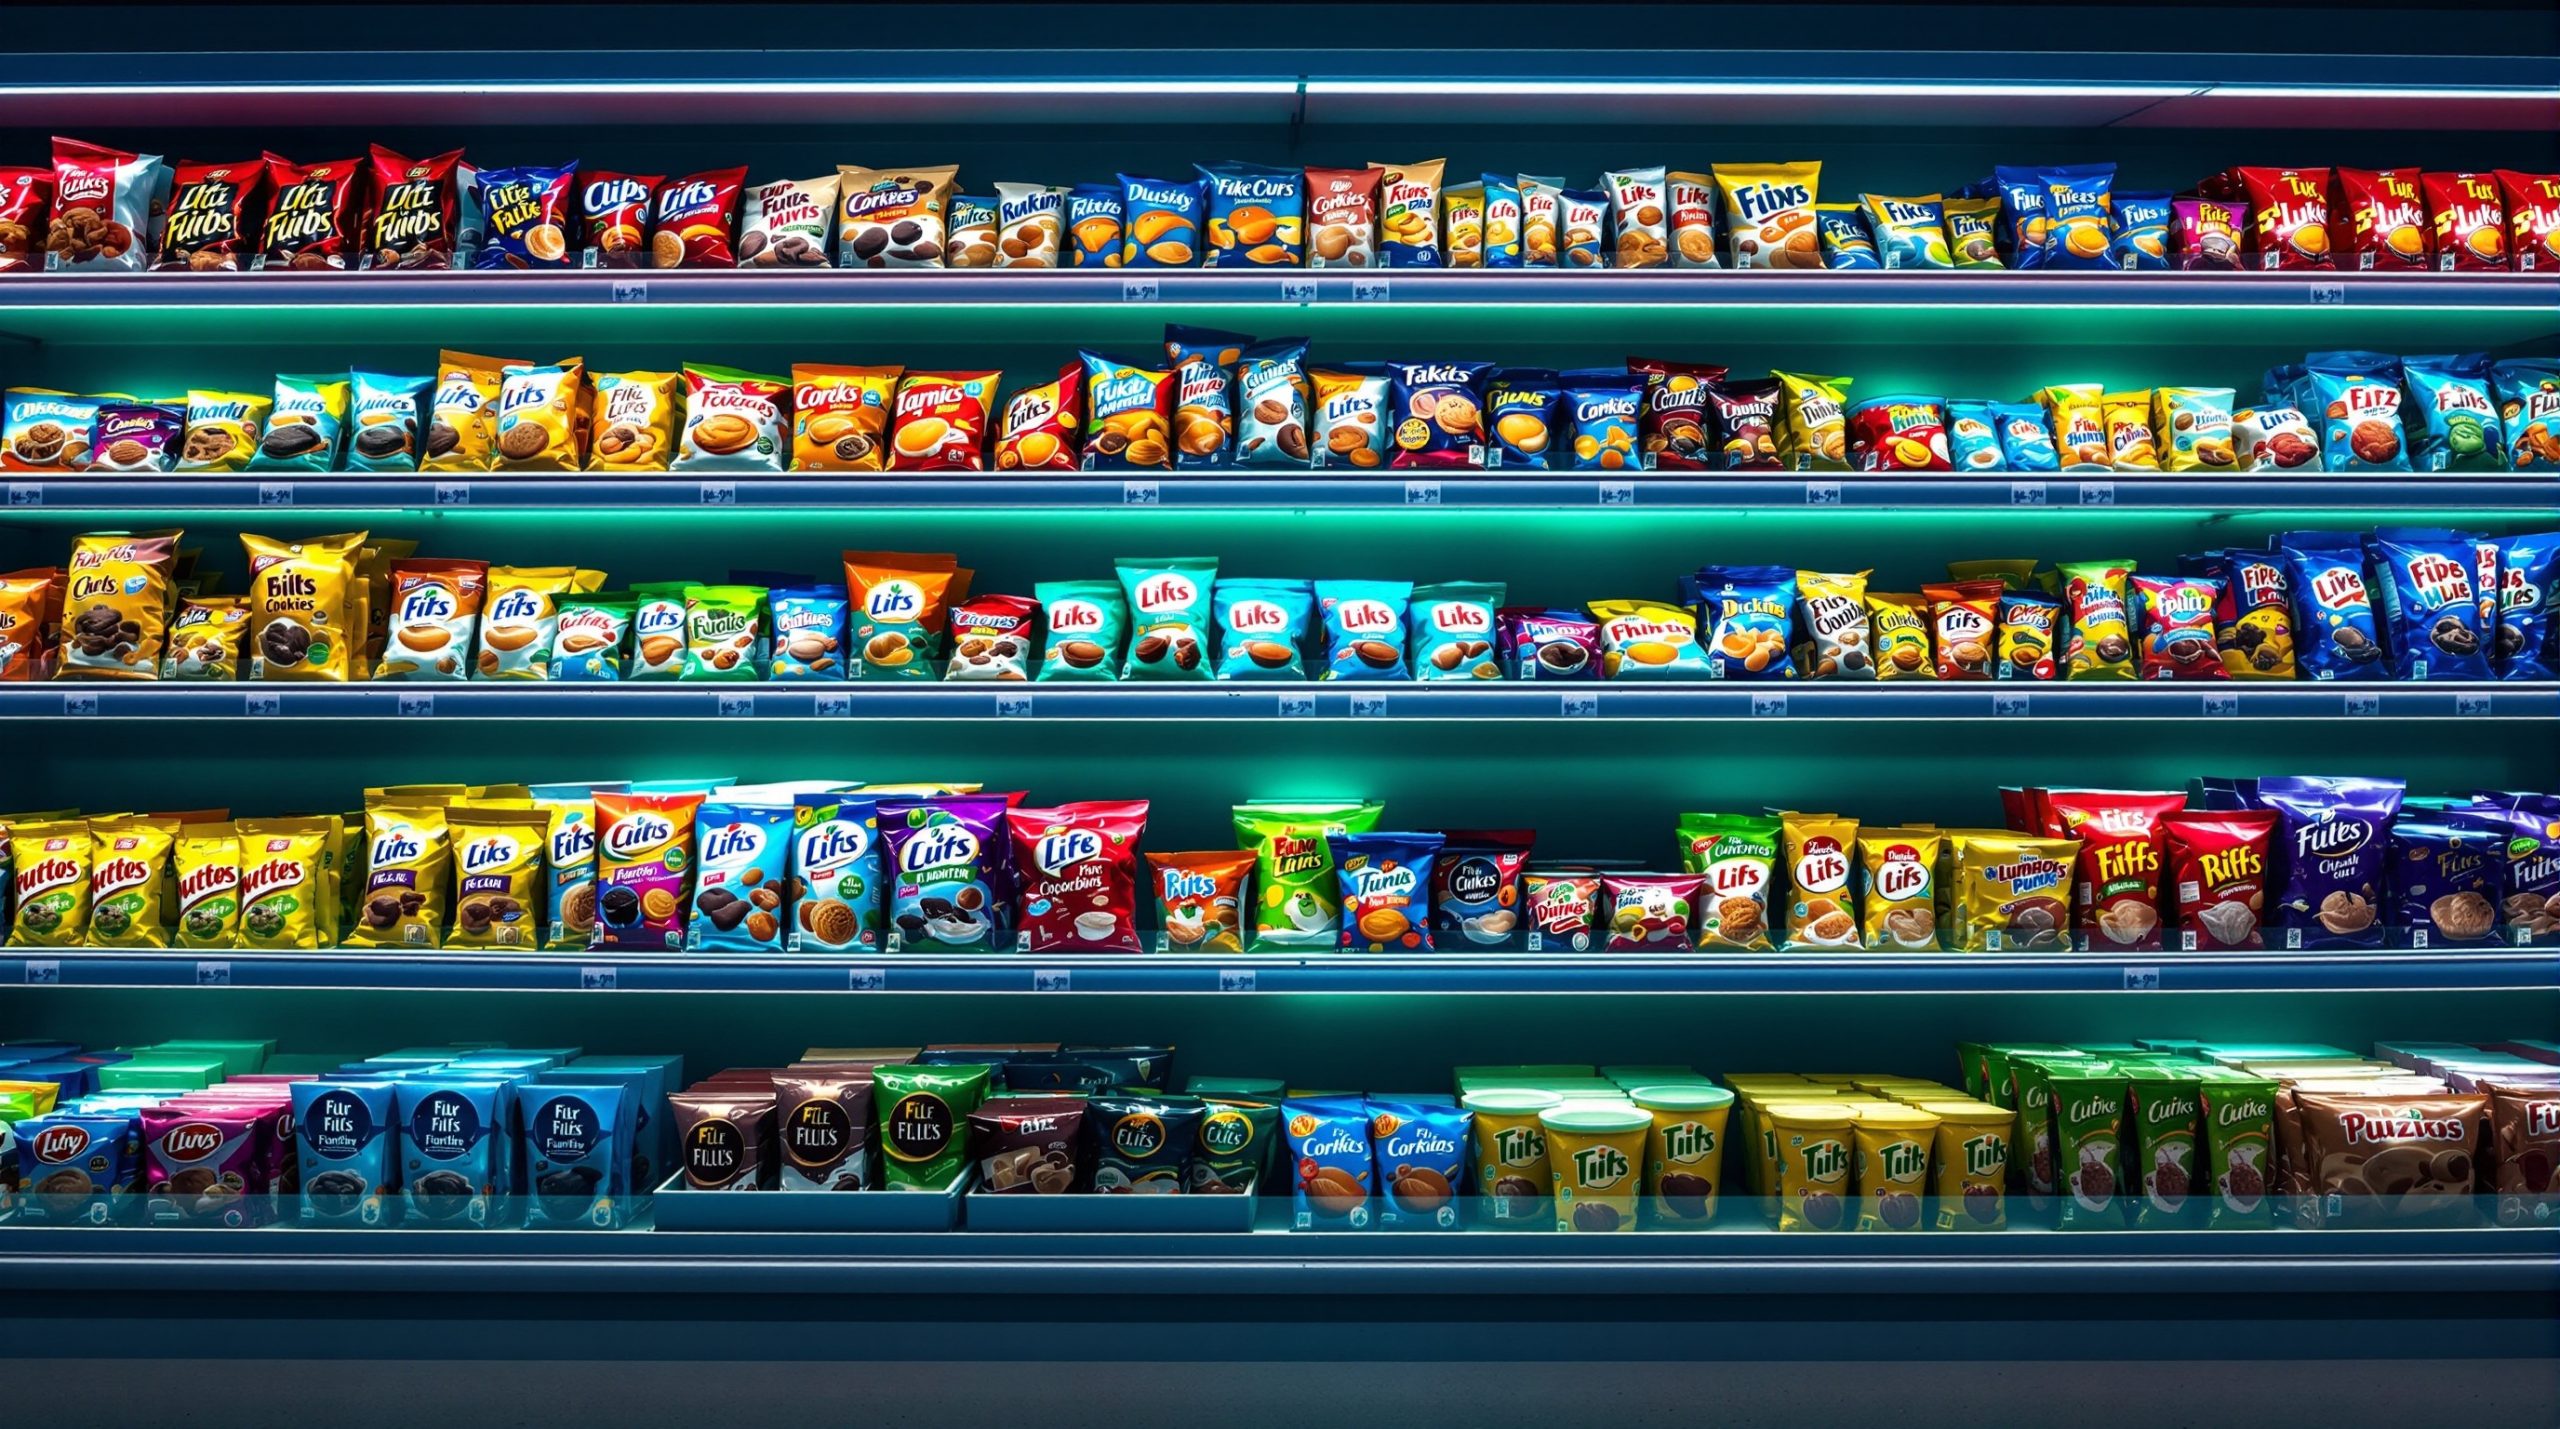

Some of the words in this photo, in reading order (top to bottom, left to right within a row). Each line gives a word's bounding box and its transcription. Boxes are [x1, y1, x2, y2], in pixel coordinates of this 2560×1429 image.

[1053, 606, 1097, 629] Liks
[1235, 605, 1280, 629] Liks
[1344, 605, 1390, 628] Liks
[1438, 604, 1483, 629] Liks
[2200, 847, 2261, 885] Riffs
